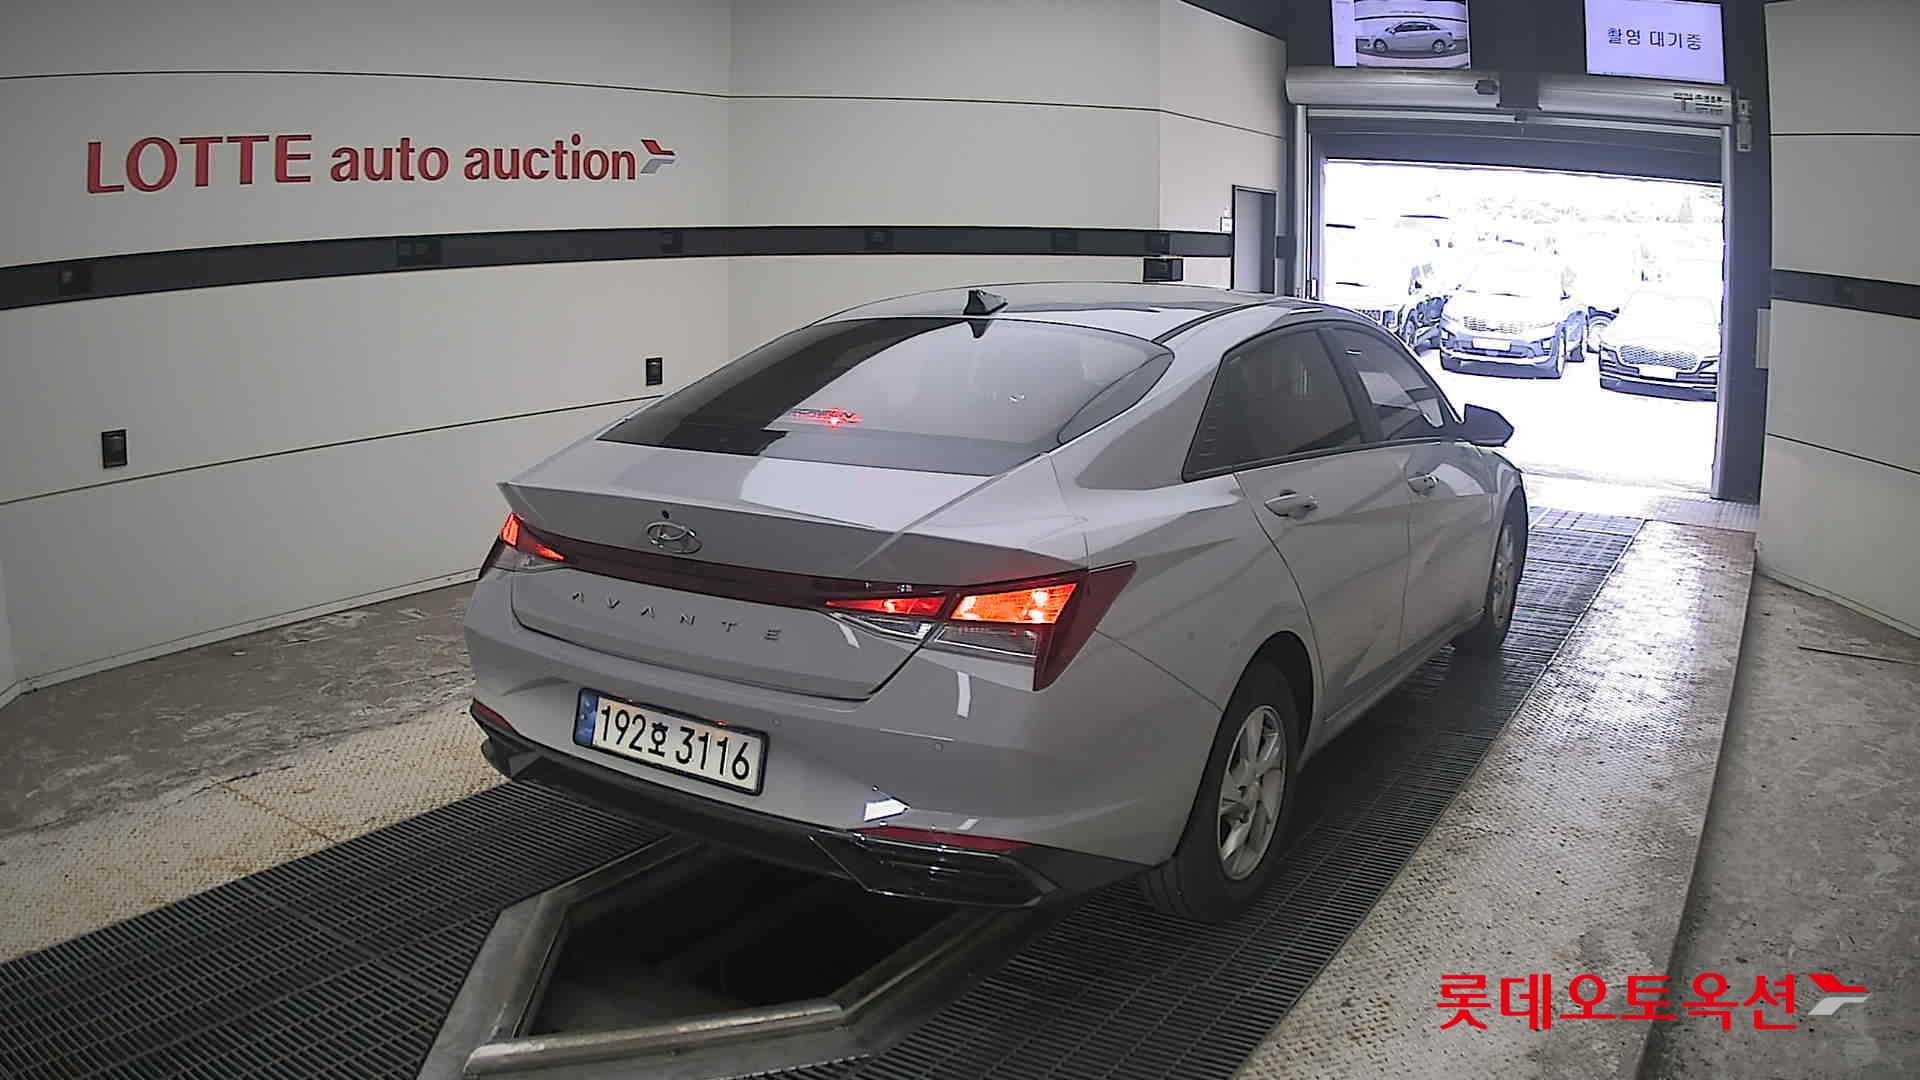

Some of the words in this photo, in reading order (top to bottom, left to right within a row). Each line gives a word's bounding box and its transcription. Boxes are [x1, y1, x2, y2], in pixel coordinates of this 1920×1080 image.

[1649, 31, 1702, 50] 대기중
[86, 133, 313, 194] LOTTE
[329, 137, 450, 182] auto
[463, 133, 637, 181] auction
[571, 591, 782, 641] AVANTE
